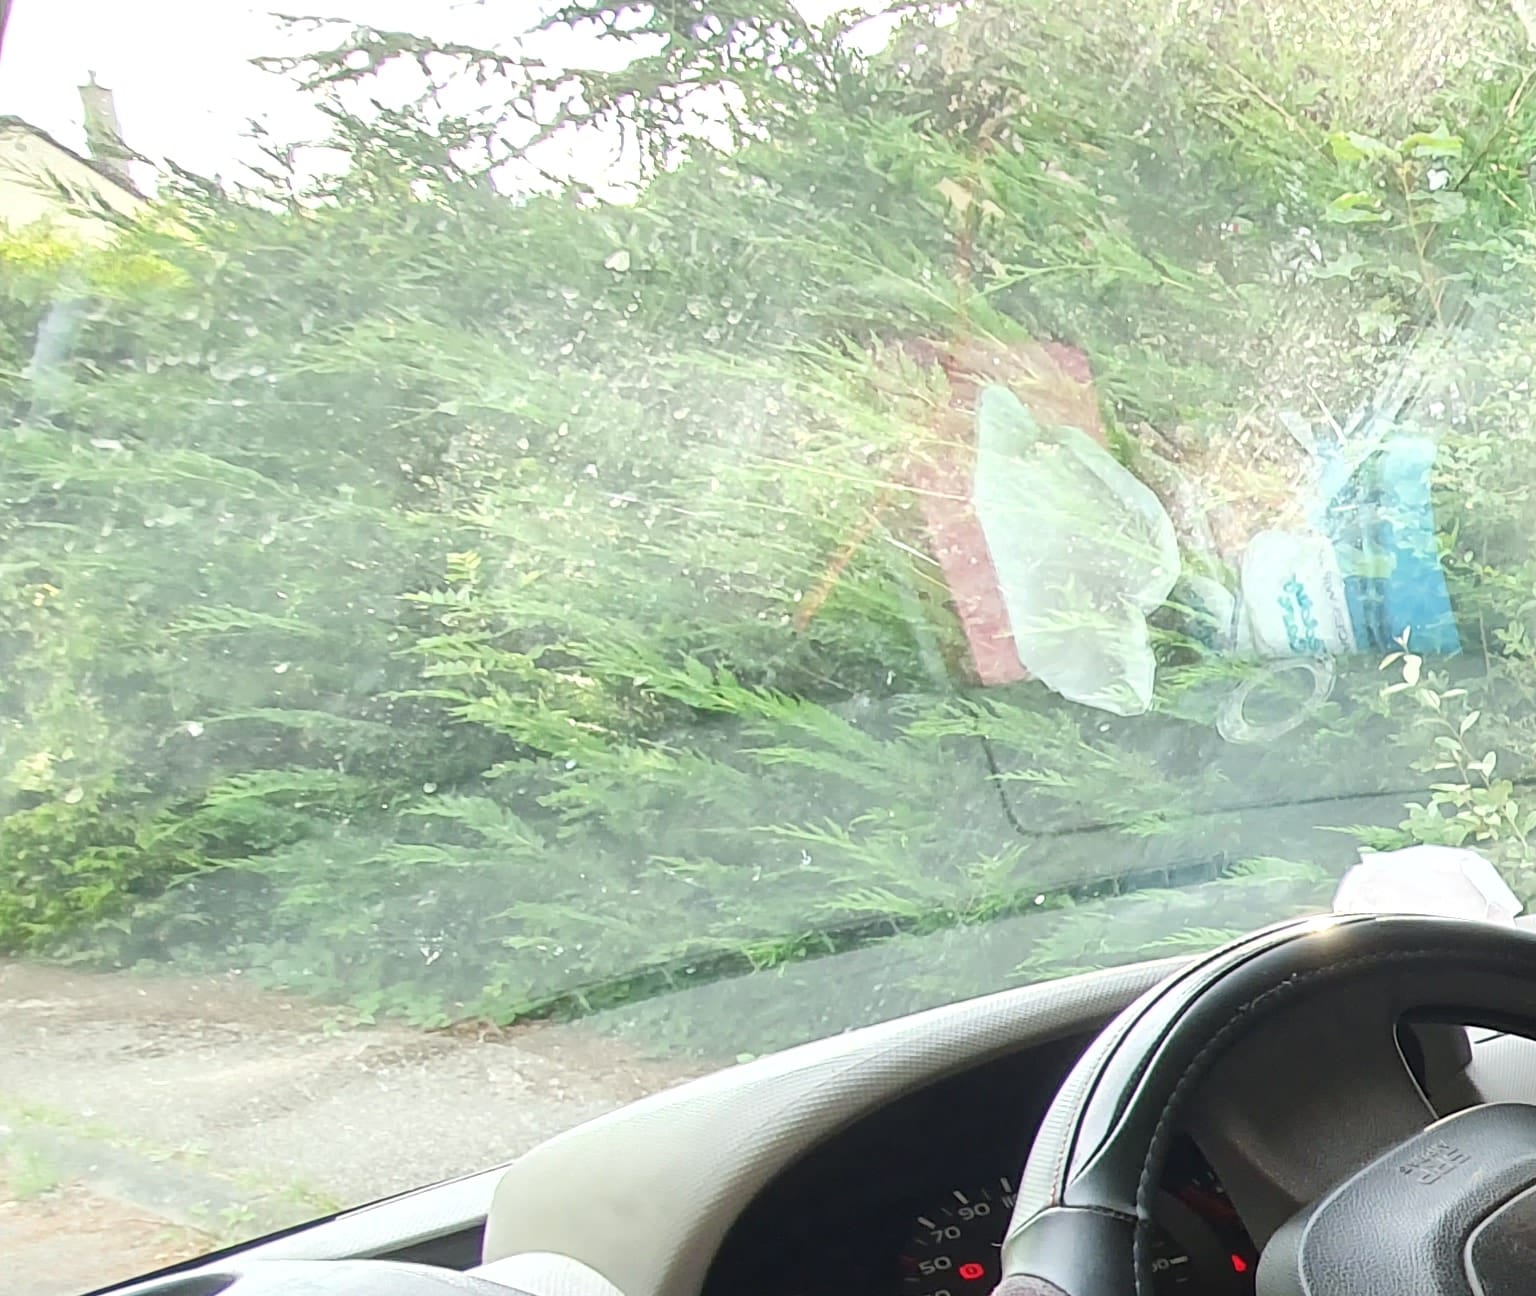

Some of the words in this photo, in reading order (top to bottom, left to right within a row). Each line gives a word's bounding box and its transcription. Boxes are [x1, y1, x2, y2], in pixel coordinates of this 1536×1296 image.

[958, 1203, 991, 1221] 90
[930, 1226, 961, 1245] 70
[919, 1256, 952, 1275] 50
